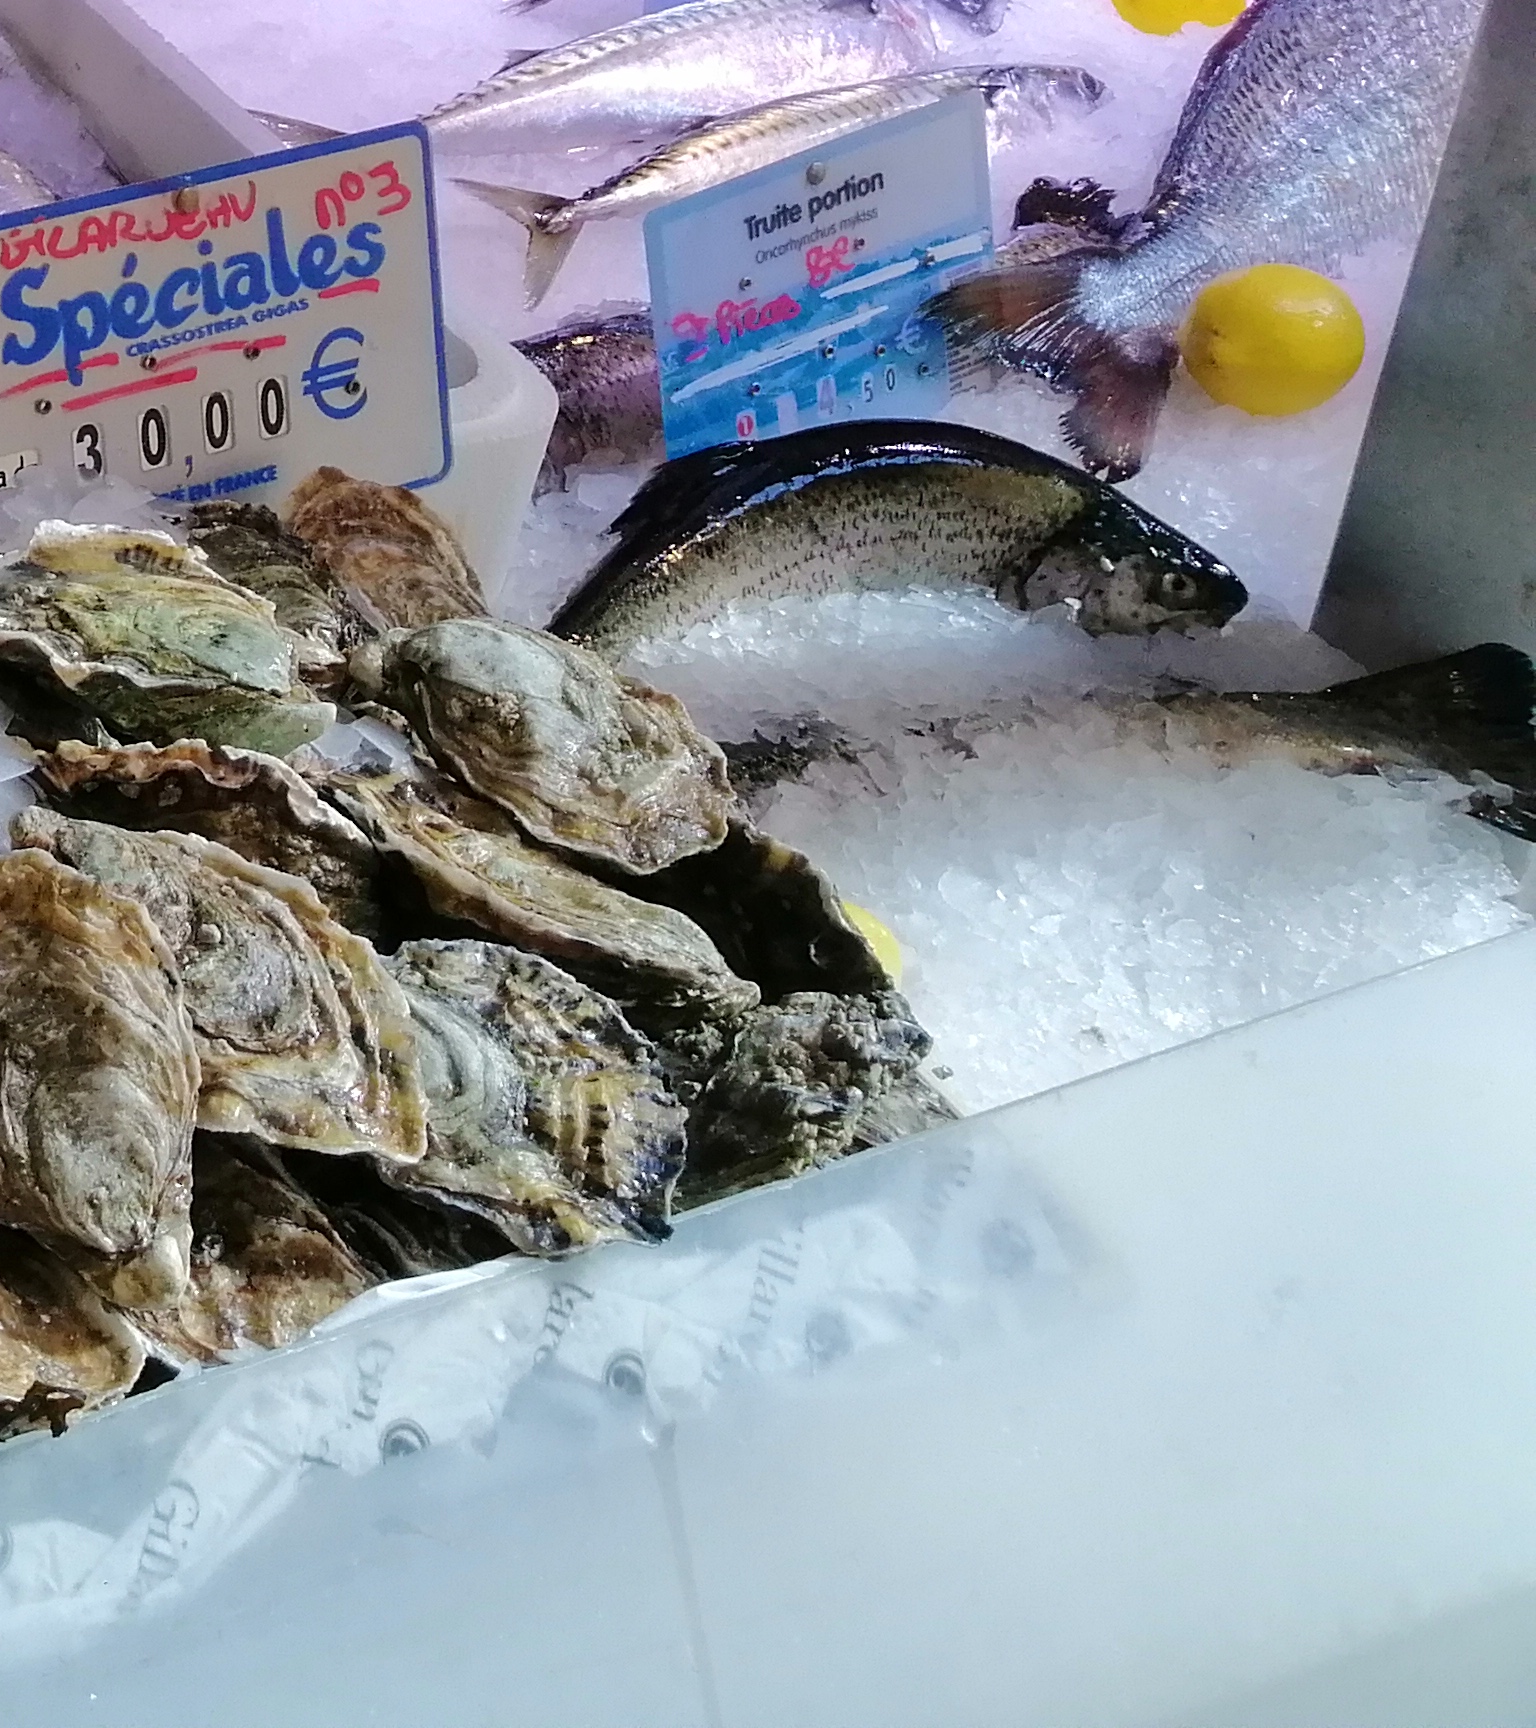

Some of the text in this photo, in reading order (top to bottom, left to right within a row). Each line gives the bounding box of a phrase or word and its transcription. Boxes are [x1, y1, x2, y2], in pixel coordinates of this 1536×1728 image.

[743, 172, 884, 242] Truite portion
[0, 207, 386, 387] Spéciales
[125, 297, 309, 357] CRASSOSTREA GIGAS
[214, 464, 278, 496] FRANCE
